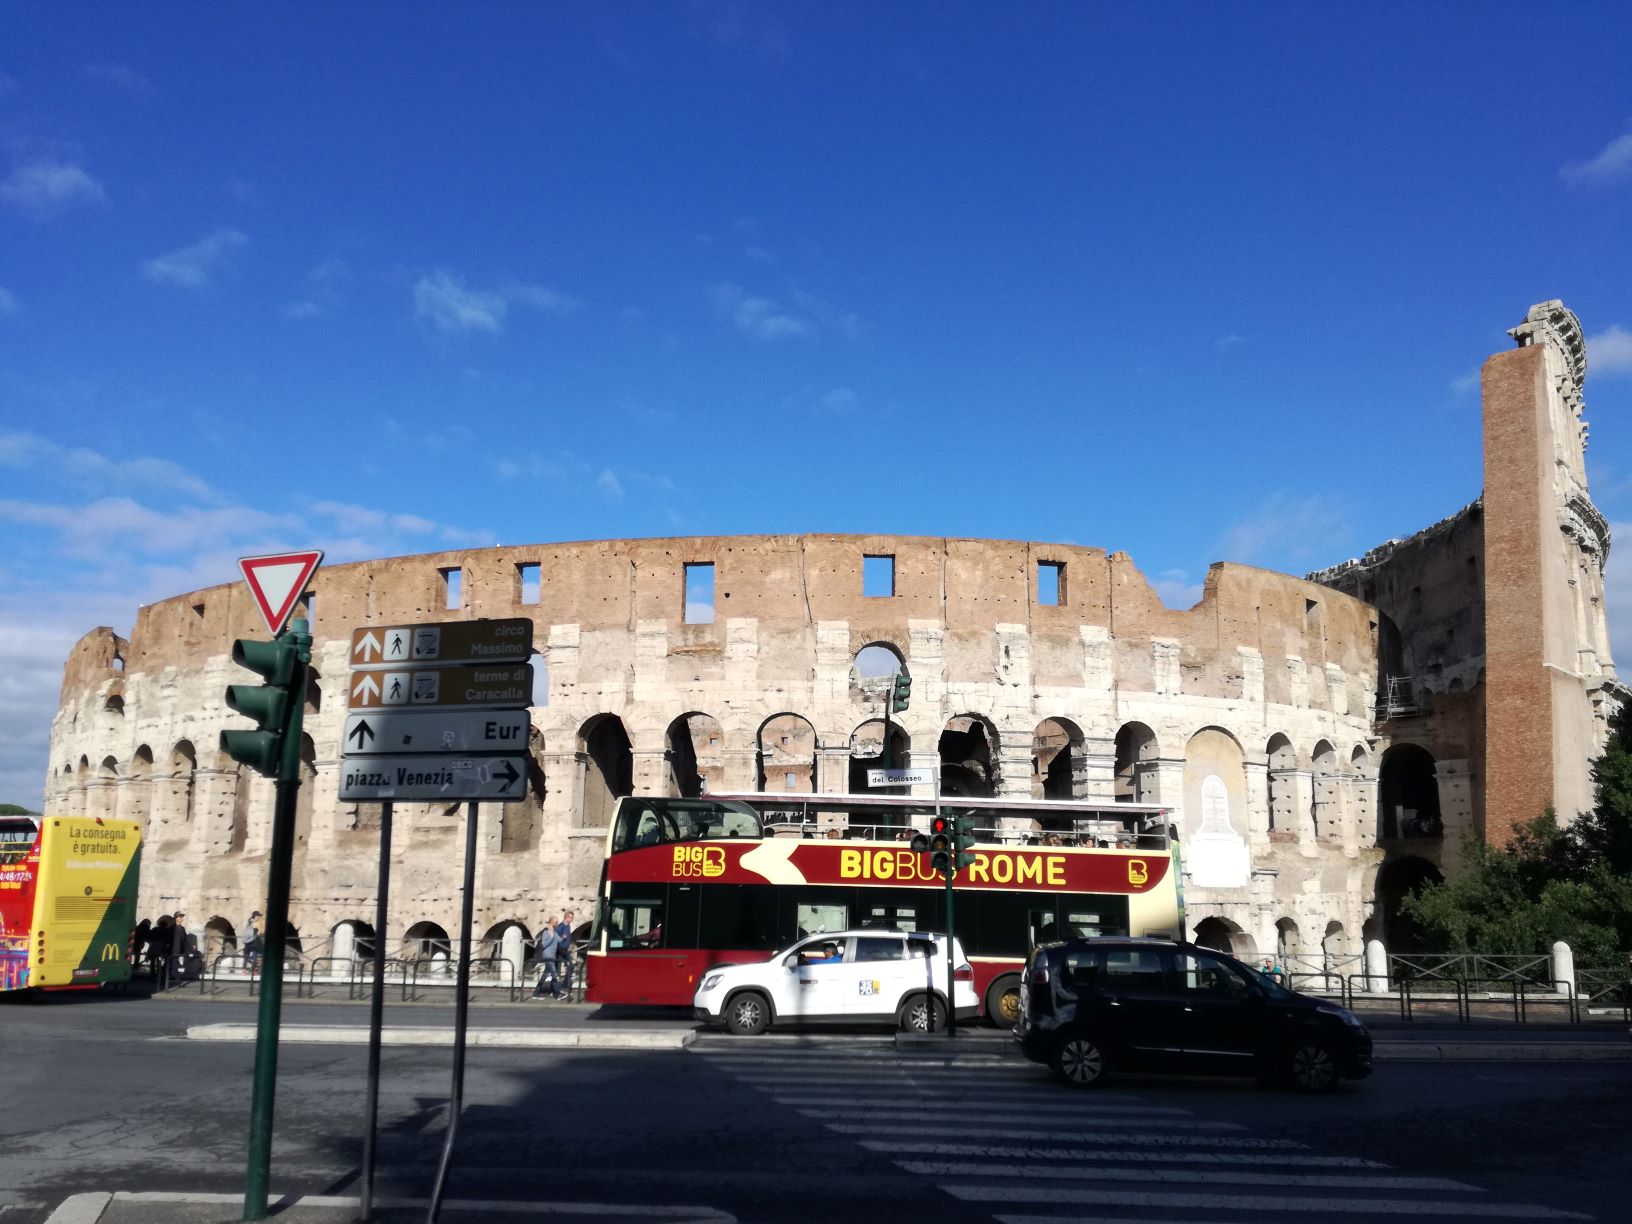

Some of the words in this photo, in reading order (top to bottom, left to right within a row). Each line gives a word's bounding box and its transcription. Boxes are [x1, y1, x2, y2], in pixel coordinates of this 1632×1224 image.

[494, 625, 525, 637] circo
[470, 643, 524, 656] Massimo
[474, 671, 510, 682] terme
[513, 669, 525, 681] di
[465, 688, 524, 701] Caracalla
[484, 721, 521, 740] Eur
[397, 768, 454, 786] Venezia
[887, 775, 922, 783] Colosseo
[69, 825, 81, 838] La
[82, 828, 126, 841] consegna
[80, 842, 121, 856] gratuita.
[673, 846, 703, 862] BIG
[672, 862, 702, 877] BUS
[969, 853, 1067, 886] ROME
